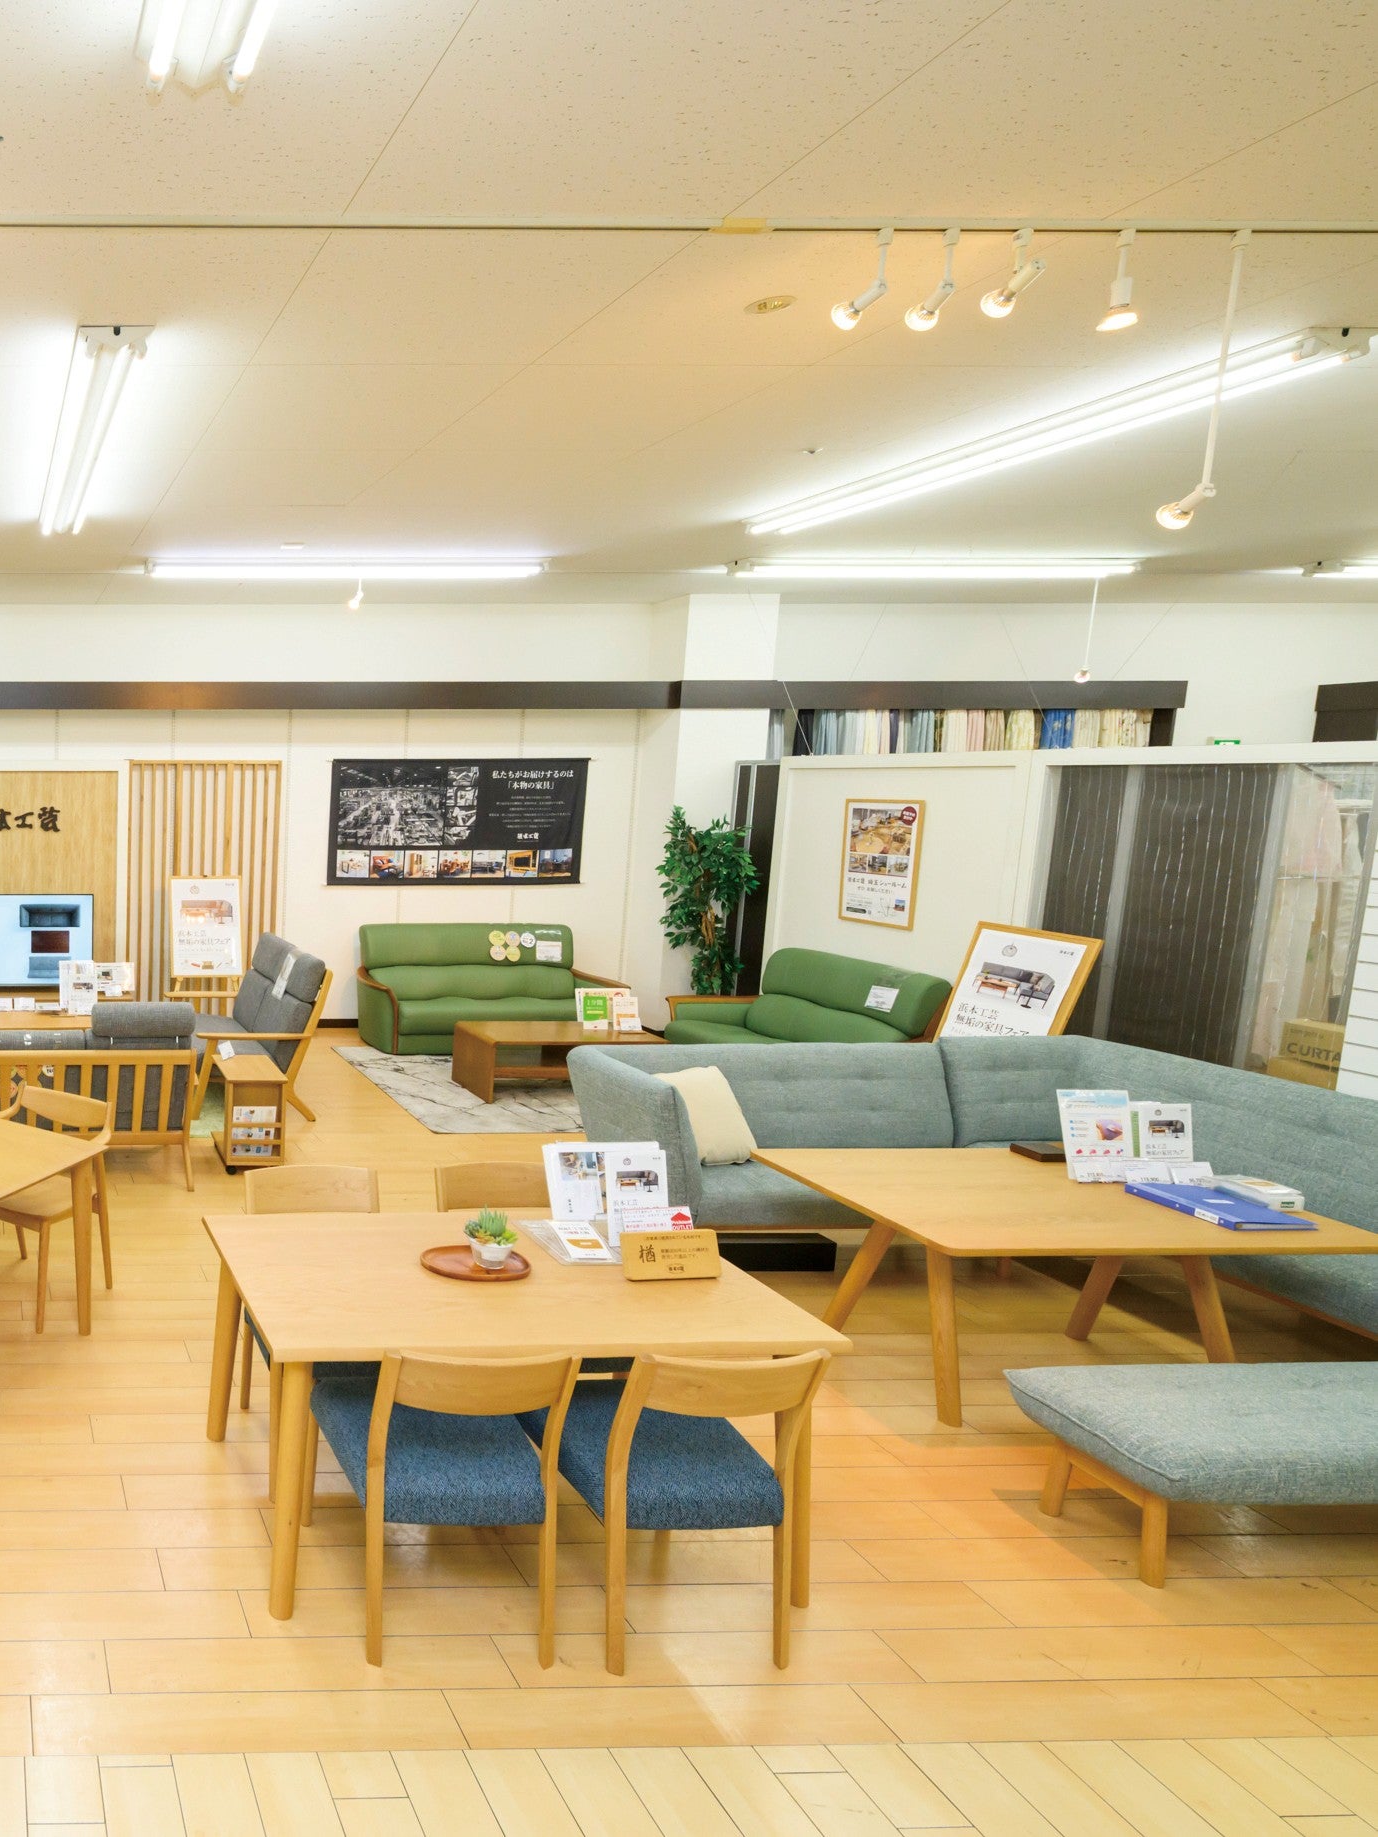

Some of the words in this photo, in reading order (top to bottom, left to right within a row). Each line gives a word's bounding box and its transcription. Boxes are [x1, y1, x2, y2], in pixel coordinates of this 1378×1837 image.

[492, 769, 574, 779] 私たちがお届けするのは
[507, 781, 555, 790] 「本物の家具」
